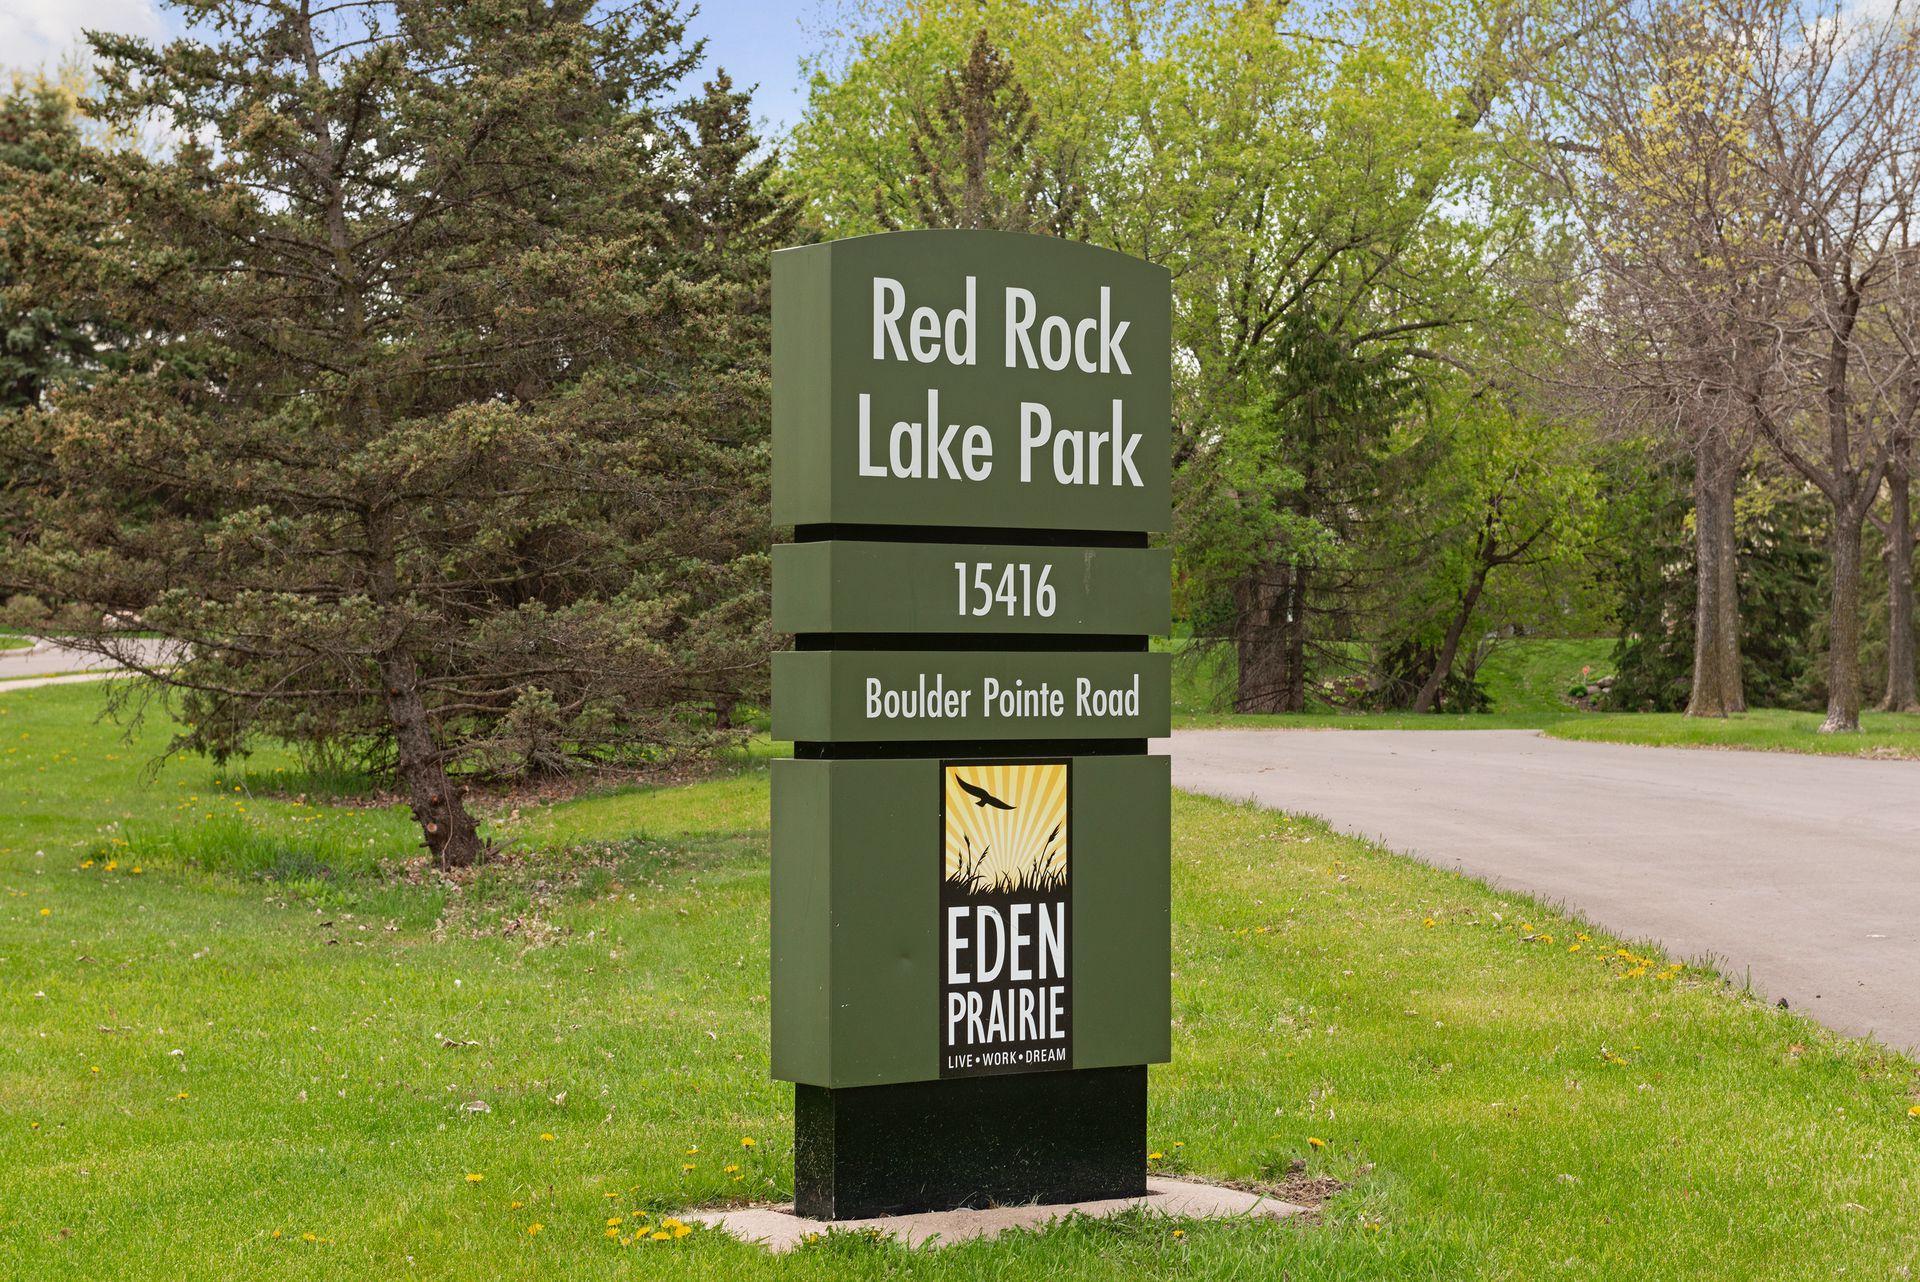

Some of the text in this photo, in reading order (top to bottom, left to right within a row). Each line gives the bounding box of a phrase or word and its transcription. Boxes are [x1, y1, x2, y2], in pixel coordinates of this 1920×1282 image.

[874, 276, 1133, 375] Red Rock
[859, 389, 1145, 487] Lake Park
[954, 562, 1057, 618] 15416
[866, 673, 1139, 719] Boulder Pointe Road
[948, 902, 1065, 985] EDEN
[948, 986, 1066, 1046] PRAIRIE
[948, 1047, 1066, 1069] LIVE WORK DREAM
